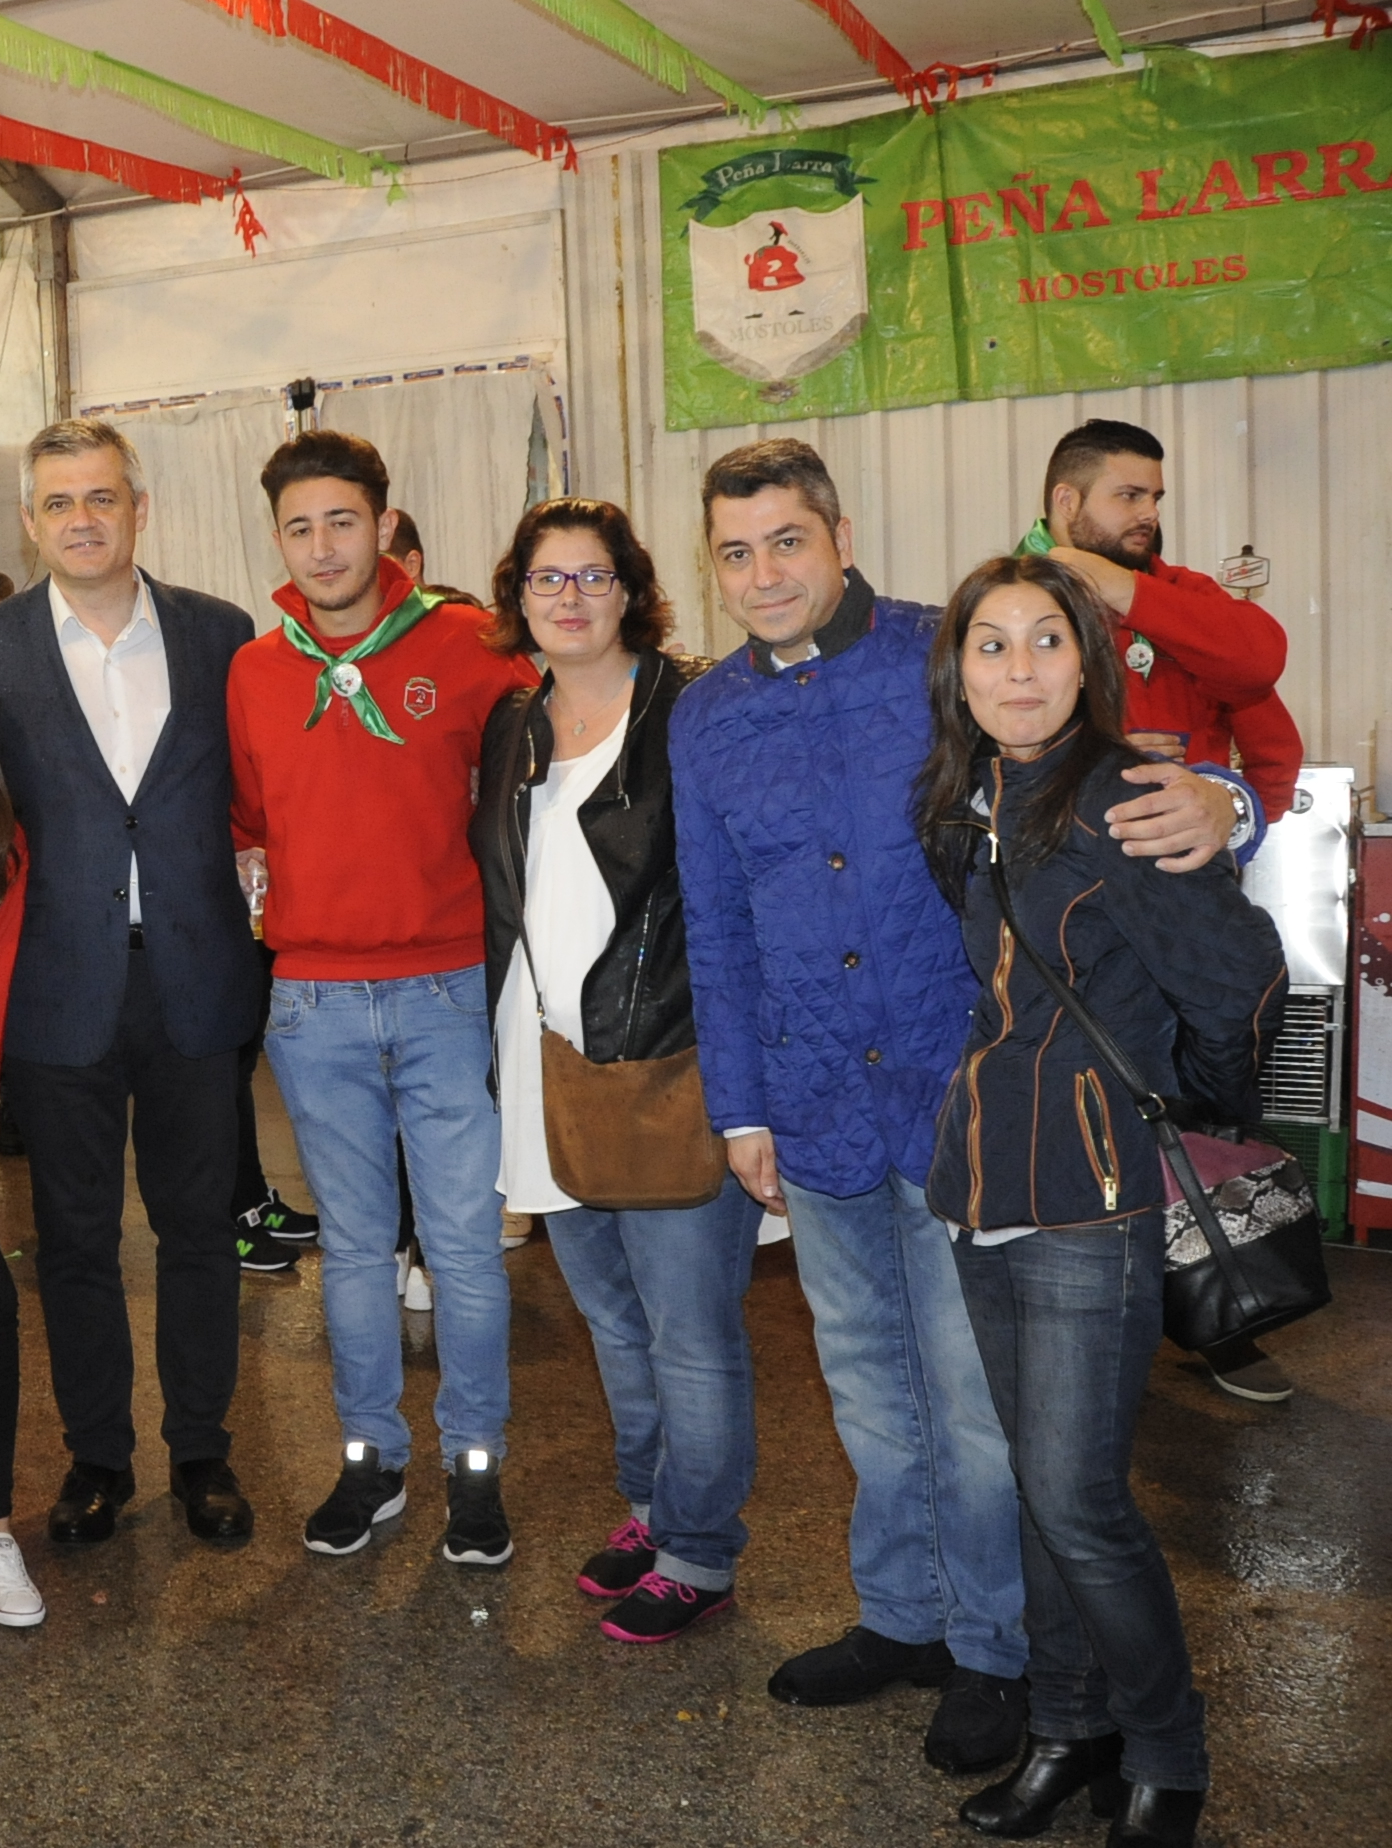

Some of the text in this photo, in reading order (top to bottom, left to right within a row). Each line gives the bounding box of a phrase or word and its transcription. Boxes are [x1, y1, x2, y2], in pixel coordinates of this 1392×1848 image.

[715, 156, 765, 189] Peña
[901, 140, 1392, 251] PEÑA LARR
[1017, 255, 1249, 304] MOSTOLES
[729, 315, 834, 343] MOSTOLES
